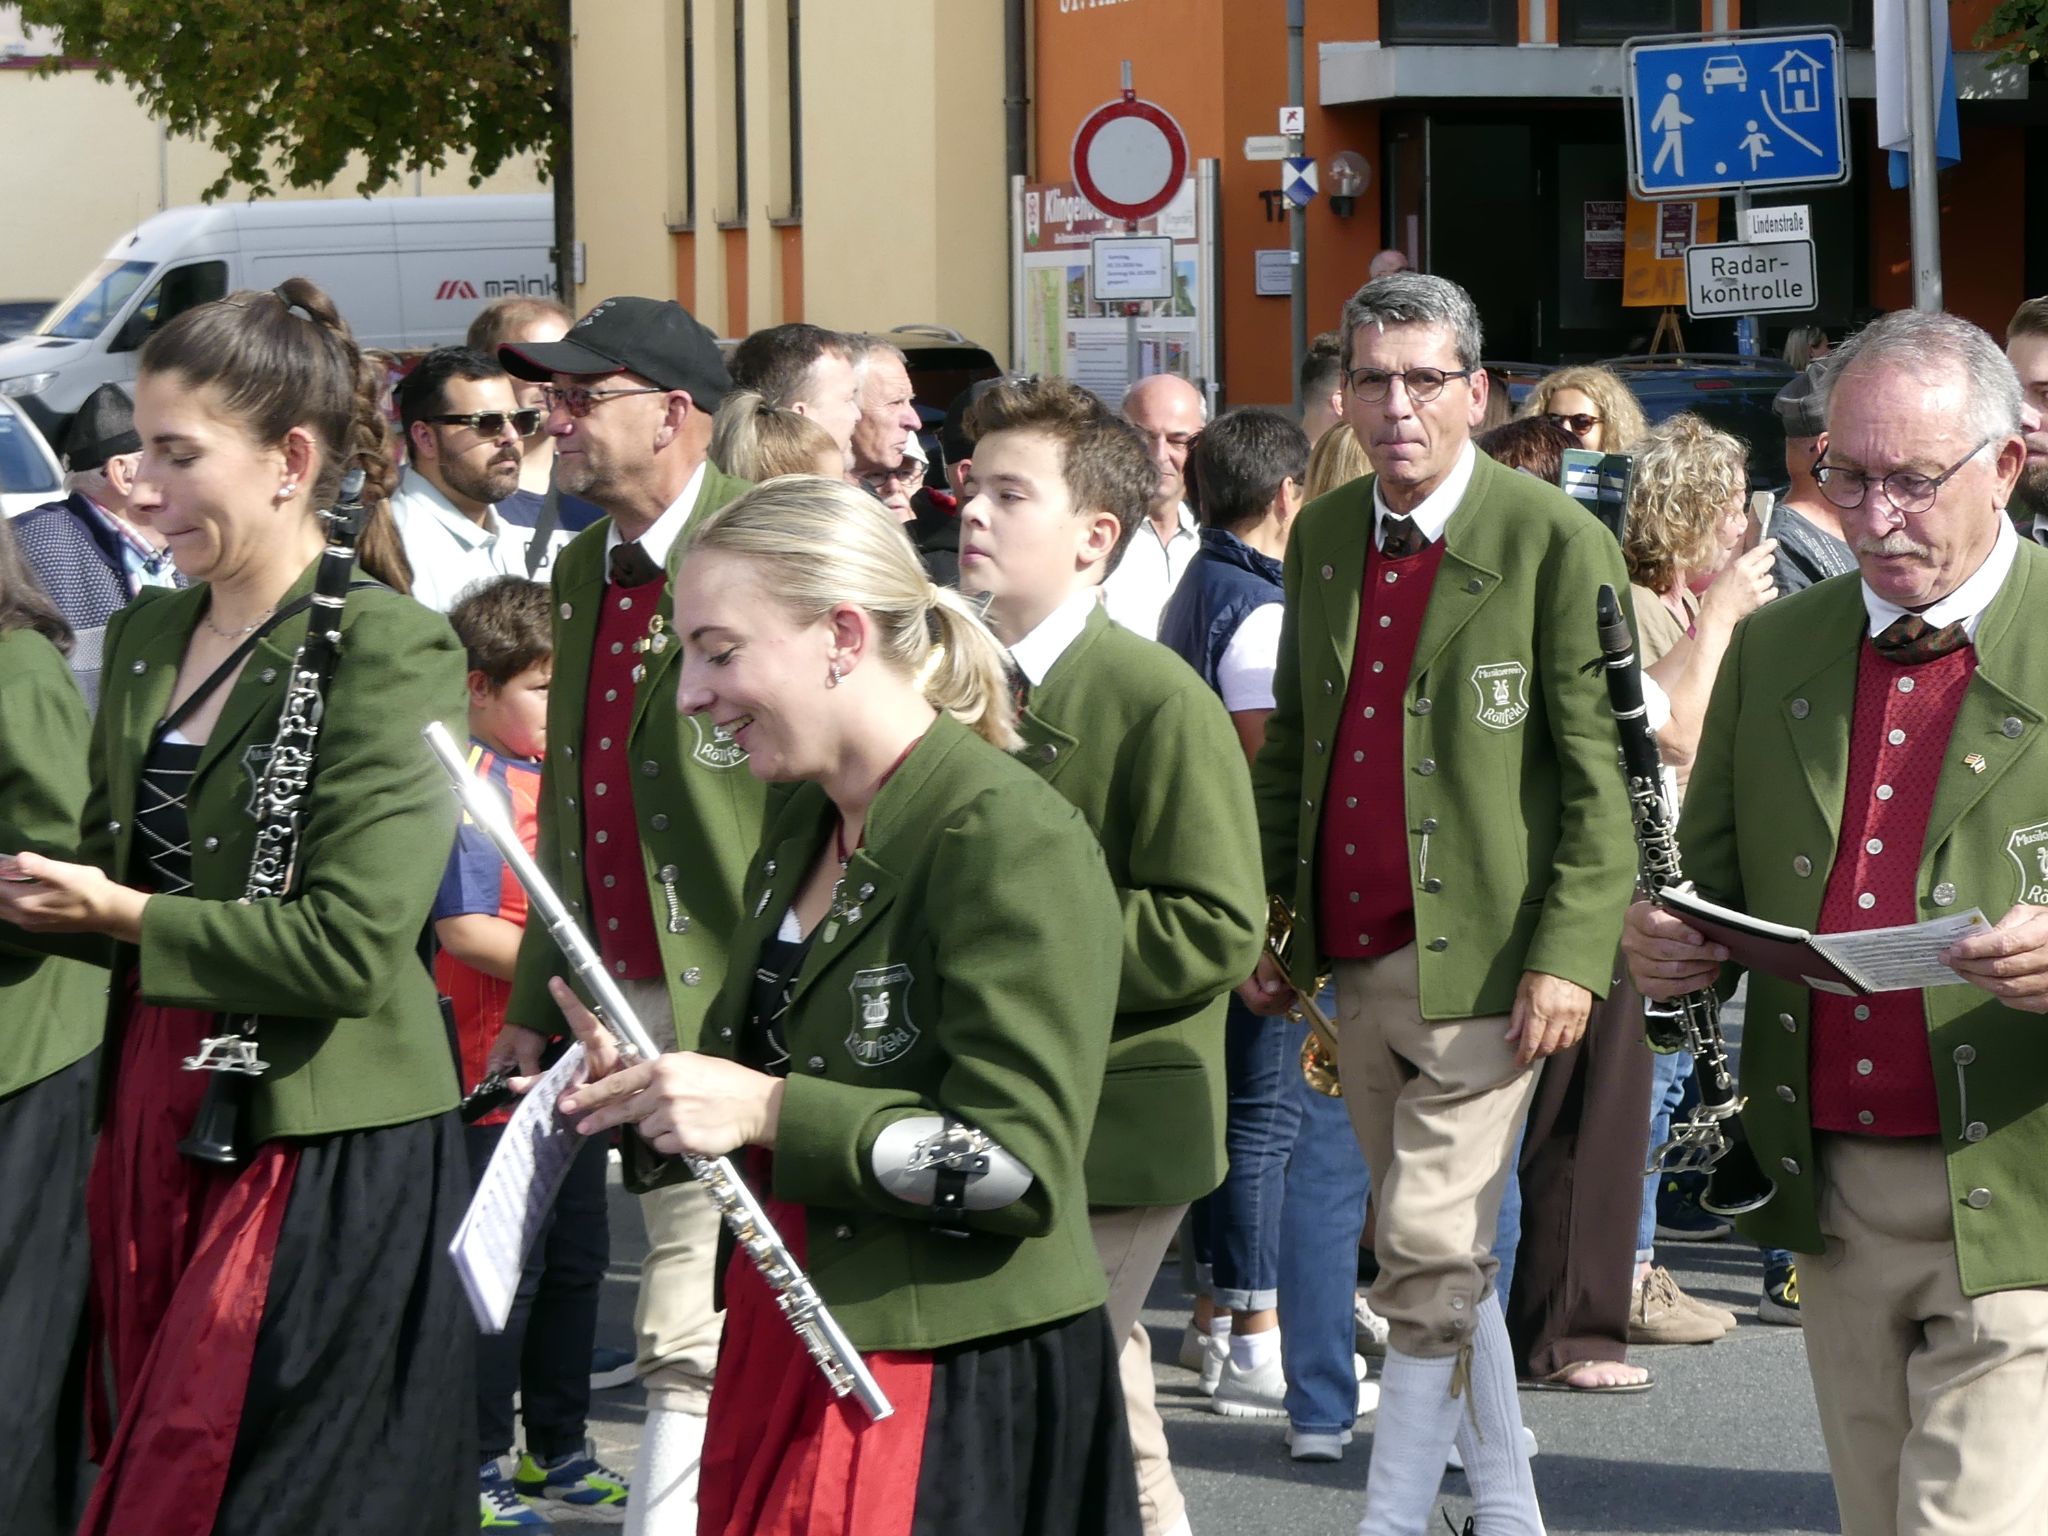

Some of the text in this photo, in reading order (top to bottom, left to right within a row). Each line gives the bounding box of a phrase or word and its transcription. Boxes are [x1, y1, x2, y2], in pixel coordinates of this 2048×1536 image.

[1753, 212, 1804, 234] Lindenstraße
[1711, 254, 1789, 276] Radar-
[1701, 279, 1803, 304] kontrolle
[701, 743, 741, 764] Röllfe
